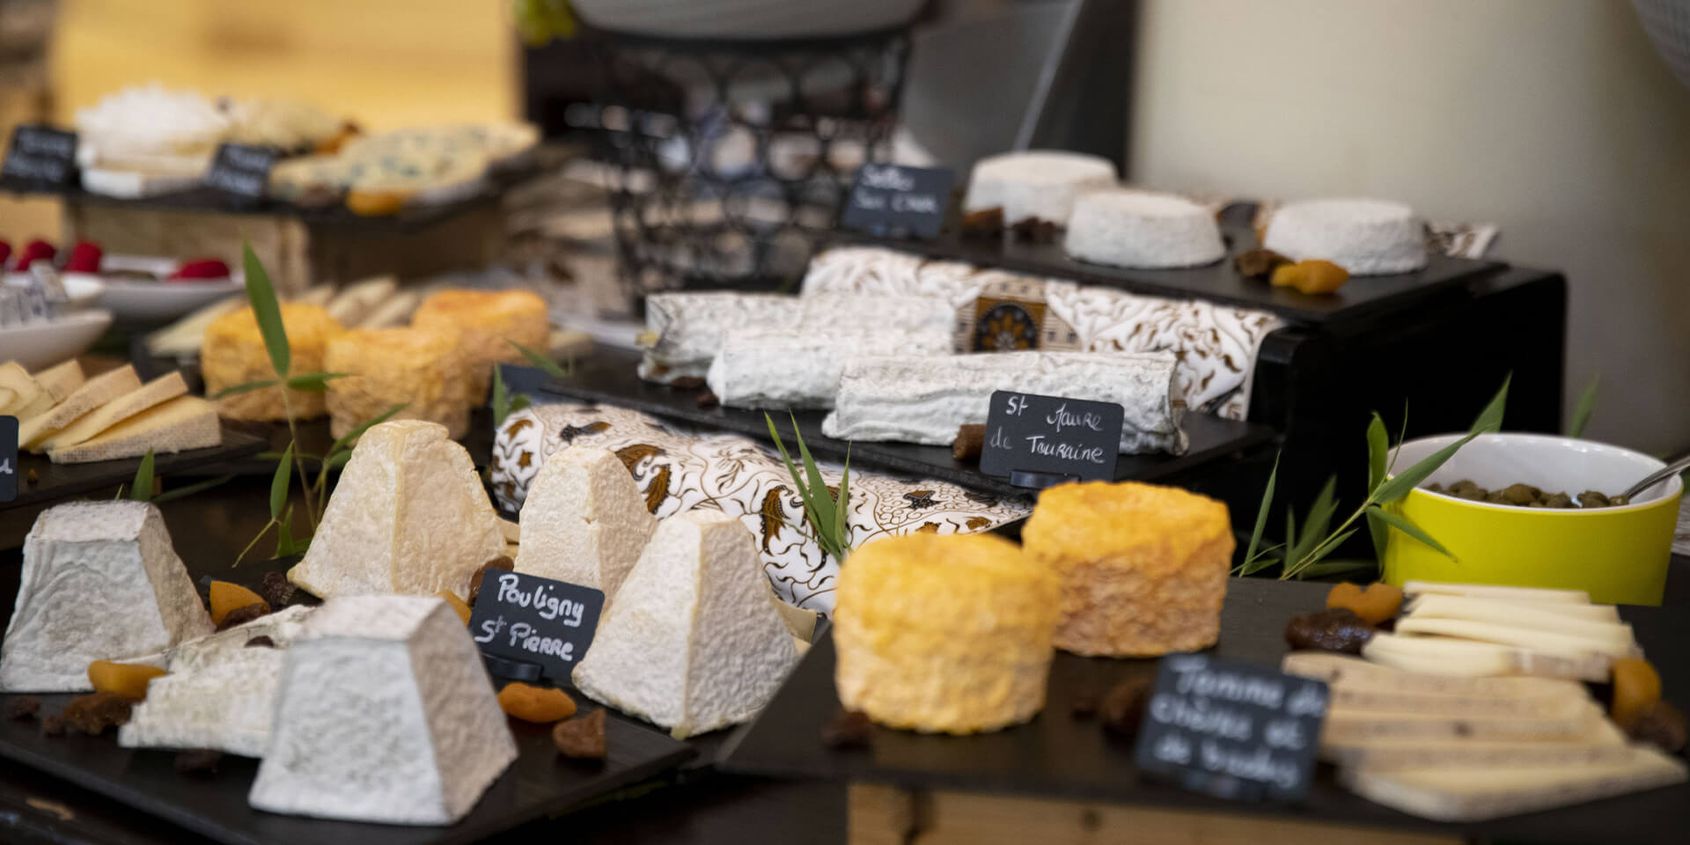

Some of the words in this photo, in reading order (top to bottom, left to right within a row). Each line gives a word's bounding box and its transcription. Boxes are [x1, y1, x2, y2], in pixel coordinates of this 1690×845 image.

[1006, 396, 1029, 416] St
[497, 573, 585, 627] Pouligny
[474, 615, 507, 643] St
[1170, 655, 1285, 709] Tomme
